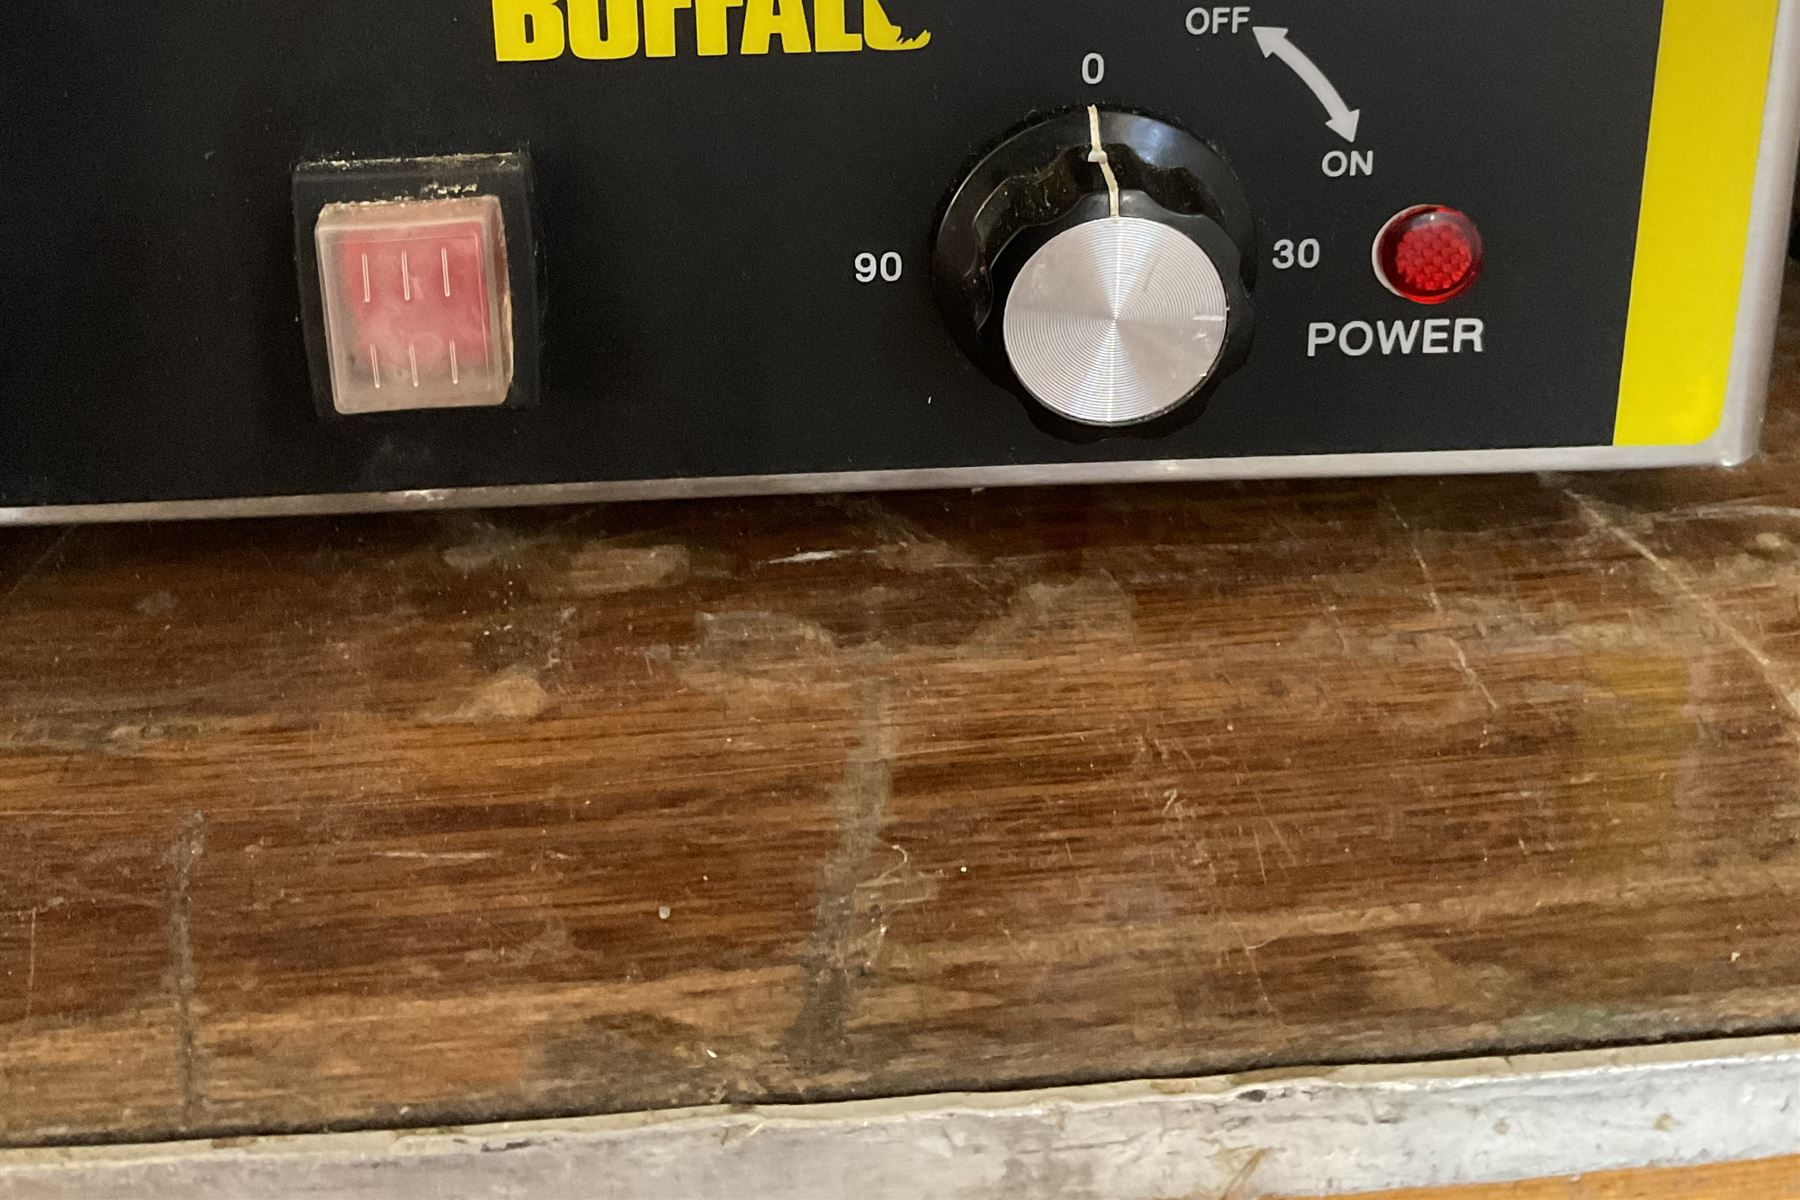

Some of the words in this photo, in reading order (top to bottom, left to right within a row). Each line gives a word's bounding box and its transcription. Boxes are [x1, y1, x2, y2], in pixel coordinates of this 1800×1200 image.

[1185, 6, 1250, 35] OFF
[1081, 52, 1105, 84] 0
[1321, 150, 1374, 177] ON
[854, 250, 903, 283] 90
[1272, 238, 1320, 270] 30
[1306, 317, 1485, 357] POWER
